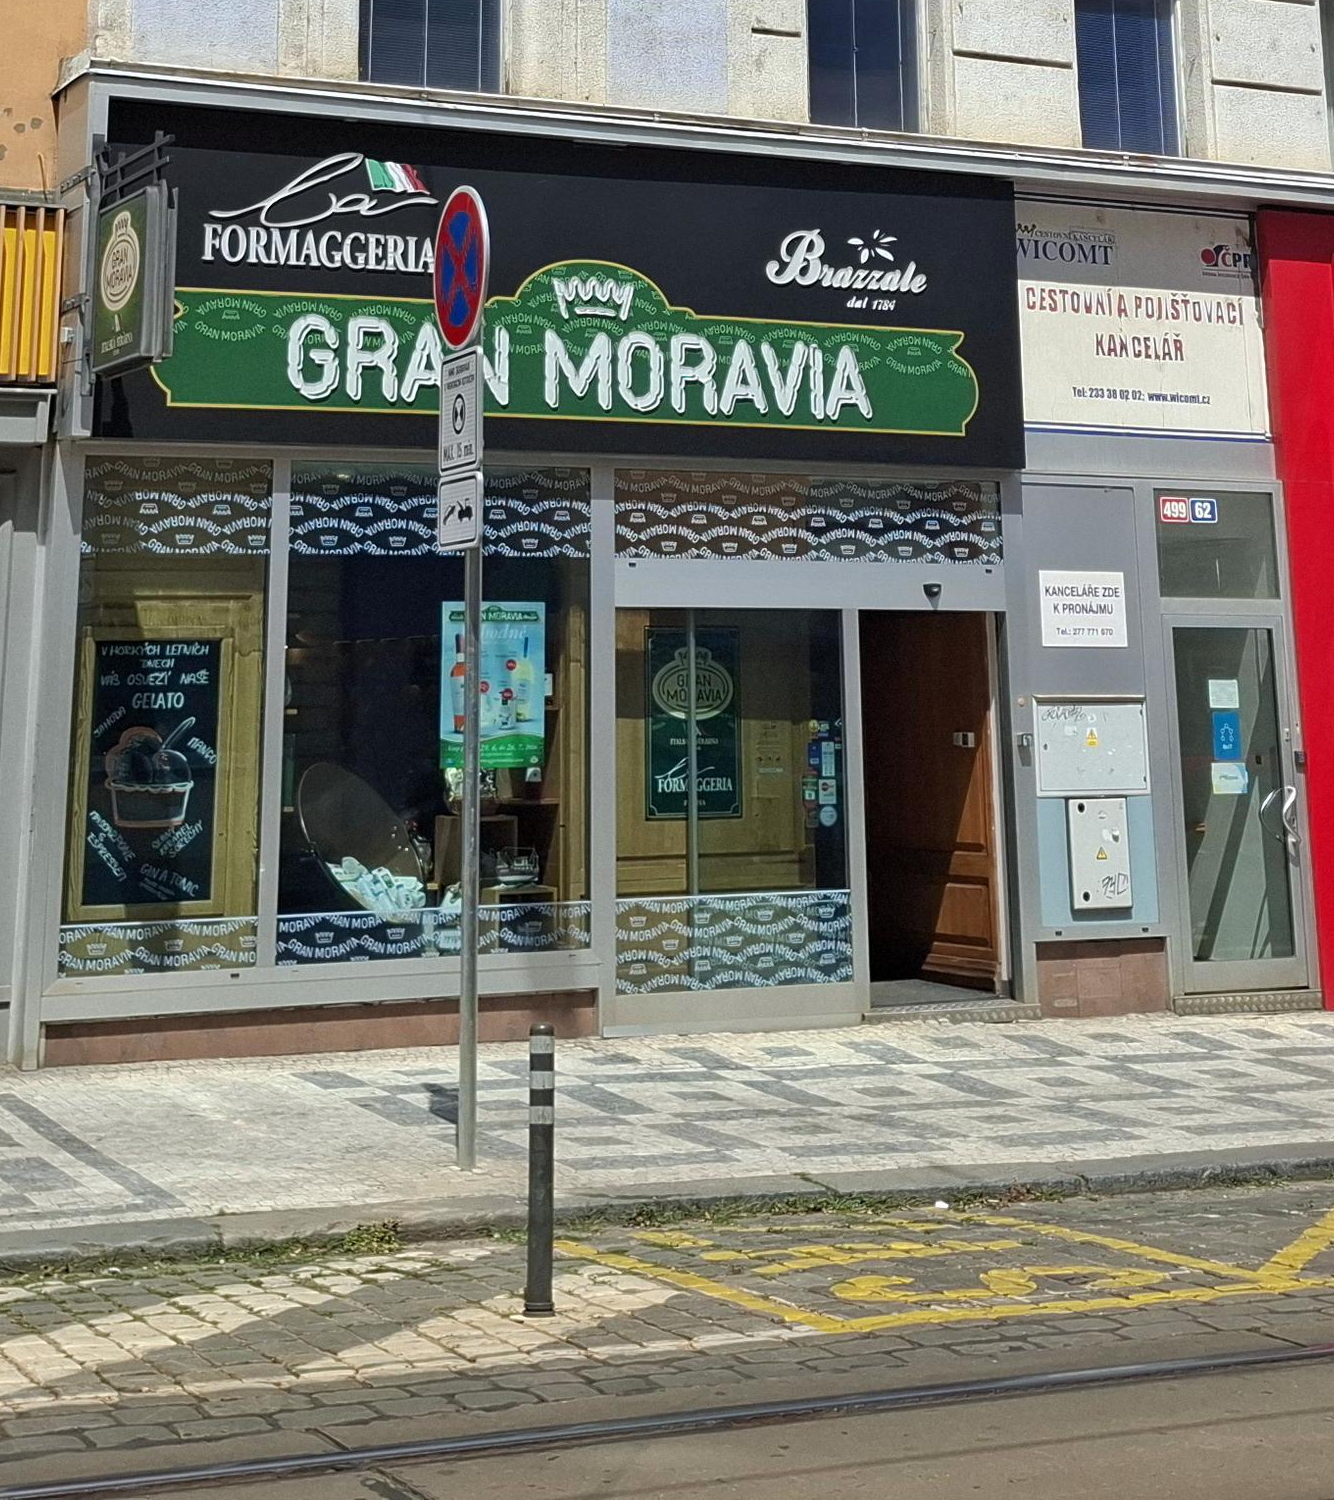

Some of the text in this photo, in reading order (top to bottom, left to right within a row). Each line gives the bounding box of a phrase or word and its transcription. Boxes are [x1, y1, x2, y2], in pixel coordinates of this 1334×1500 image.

[202, 223, 435, 275] FORMAGGERIA
[1017, 238, 1114, 266] WICOMT
[766, 229, 927, 293] Brazzale
[847, 296, 896, 311] dal 1784
[1025, 286, 1245, 326] CESTOVNÍ A POJIŠŤOVACÍ
[195, 321, 267, 342] GRAN MORAVIA
[1095, 332, 1185, 362] KANCELÁŘ
[544, 328, 873, 421] MORAVIA
[885, 356, 943, 376] GRAN MORAVIA
[1088, 387, 1105, 399] 233
[1106, 389, 1117, 399] 38
[1119, 390, 1130, 401] 02
[1163, 502, 1186, 518] 499
[1194, 503, 1212, 518] 62
[1045, 584, 1120, 598] KANCELÁŘE ZDE
[1053, 601, 1114, 614] K PRONÁJMU
[1072, 628, 1086, 636] 277
[1088, 628, 1099, 636] 771
[677, 673, 712, 687] GAN
[132, 691, 185, 710] GELATO
[667, 688, 723, 702] MOAVIA
[134, 944, 209, 967] GRAN MORAVIA
[211, 942, 238, 962] GRAN
[288, 937, 359, 959] GRAN MORAVIA
[58, 948, 133, 971] GRAN MORAVIA
